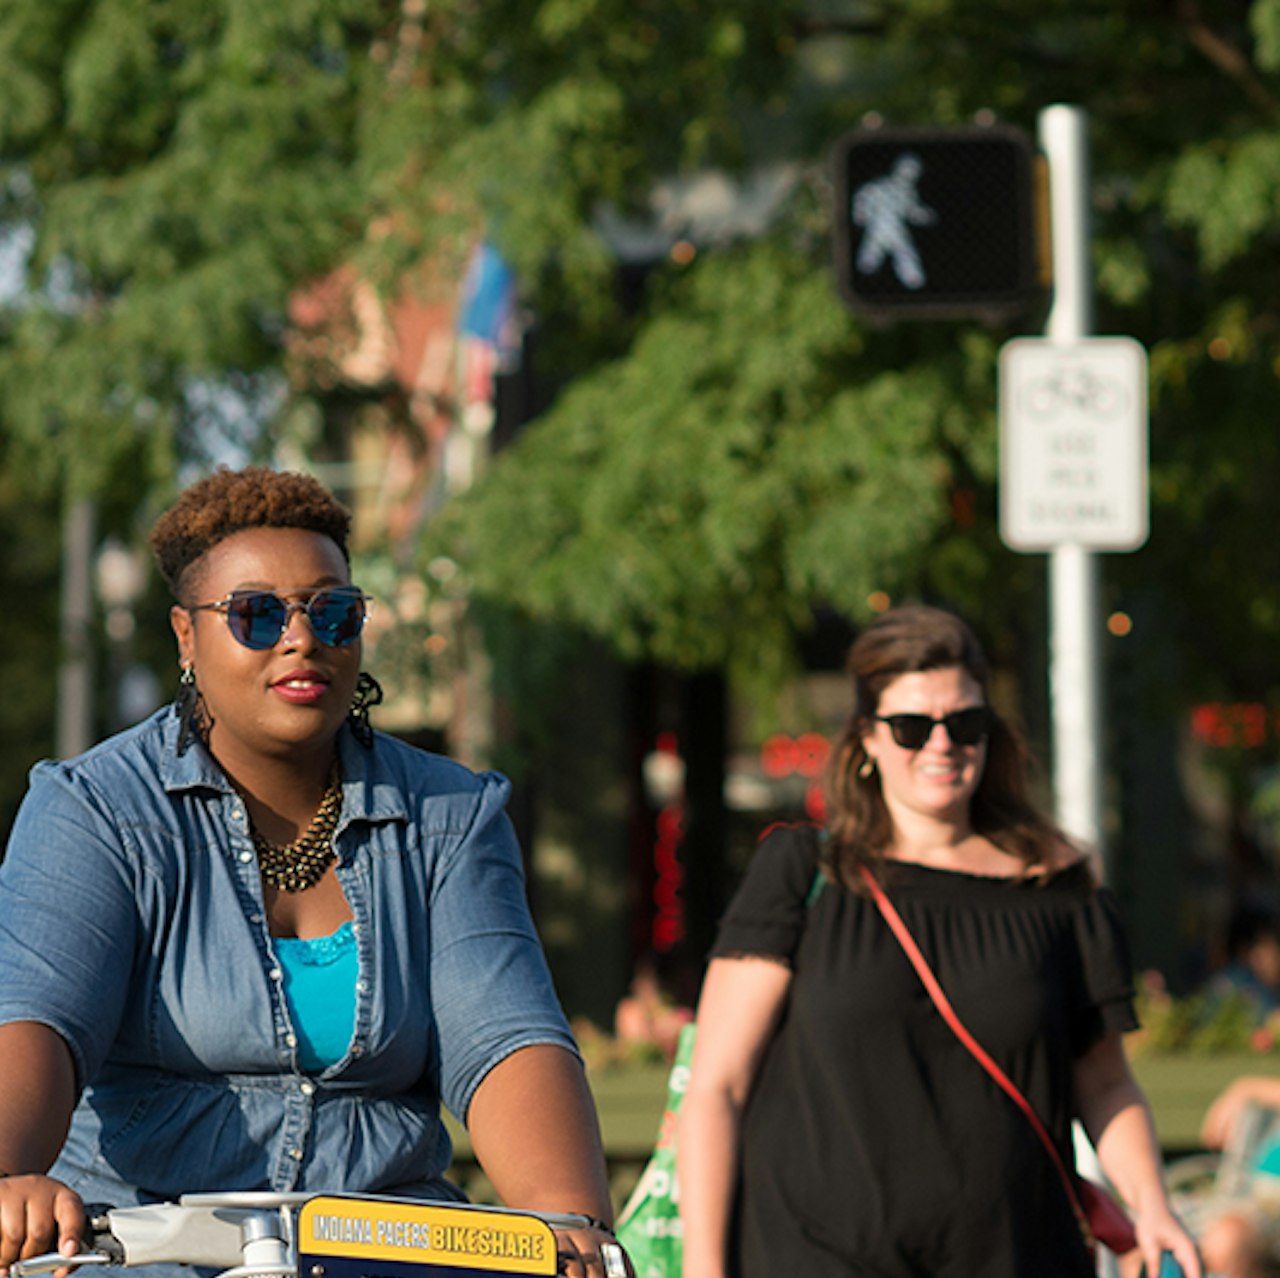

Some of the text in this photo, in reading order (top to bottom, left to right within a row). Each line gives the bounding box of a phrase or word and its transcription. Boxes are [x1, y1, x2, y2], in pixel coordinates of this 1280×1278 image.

[313, 1214, 545, 1261] INDIANA PACERS BIKESHARE
